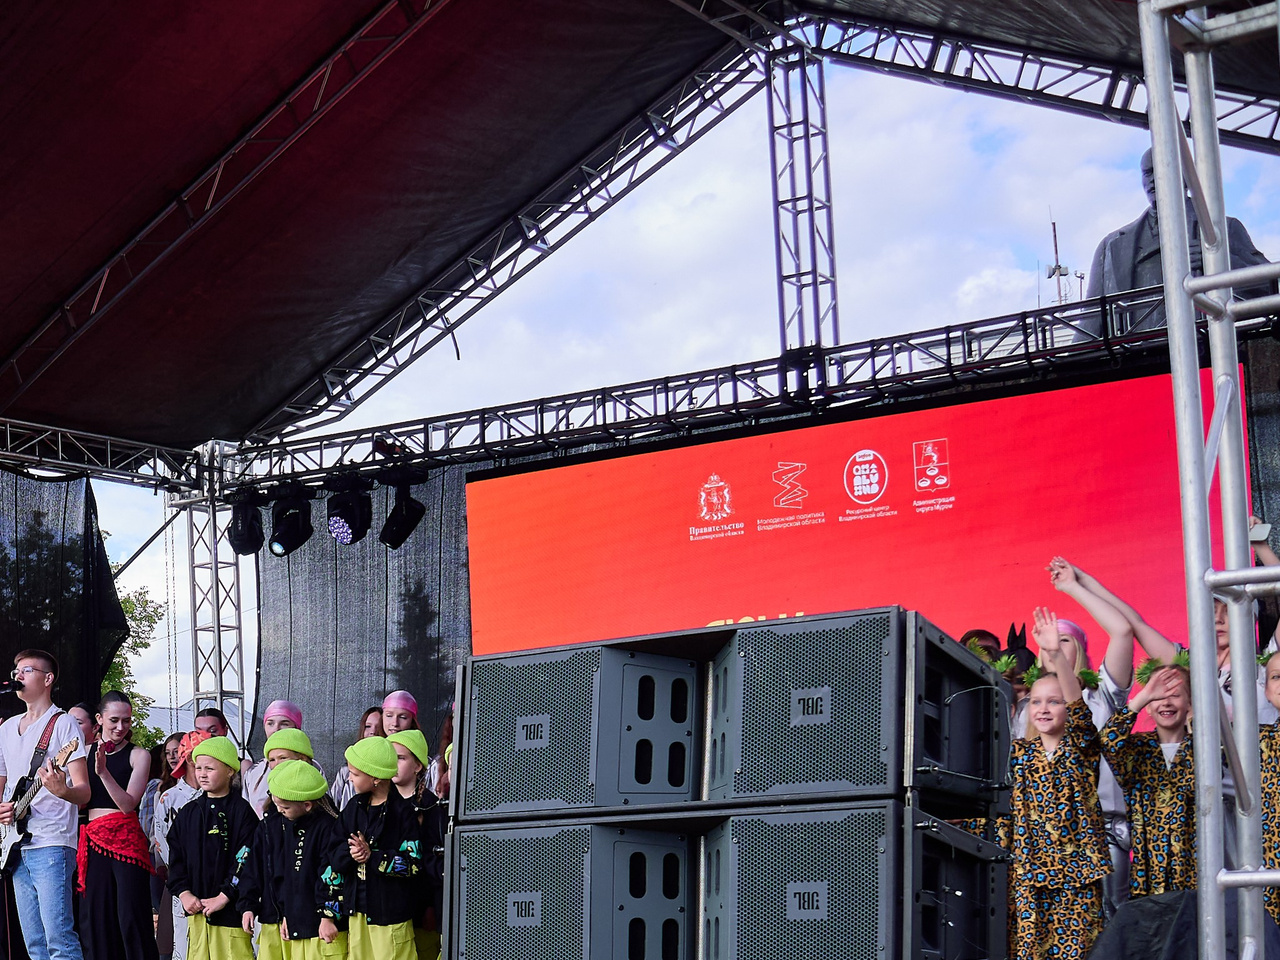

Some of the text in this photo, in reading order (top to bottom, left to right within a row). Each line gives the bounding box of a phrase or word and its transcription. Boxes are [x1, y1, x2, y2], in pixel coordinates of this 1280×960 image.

[798, 696, 823, 716] JBL
[522, 723, 543, 741] JBL
[512, 900, 535, 918] JBL
[793, 891, 820, 910] JBL
